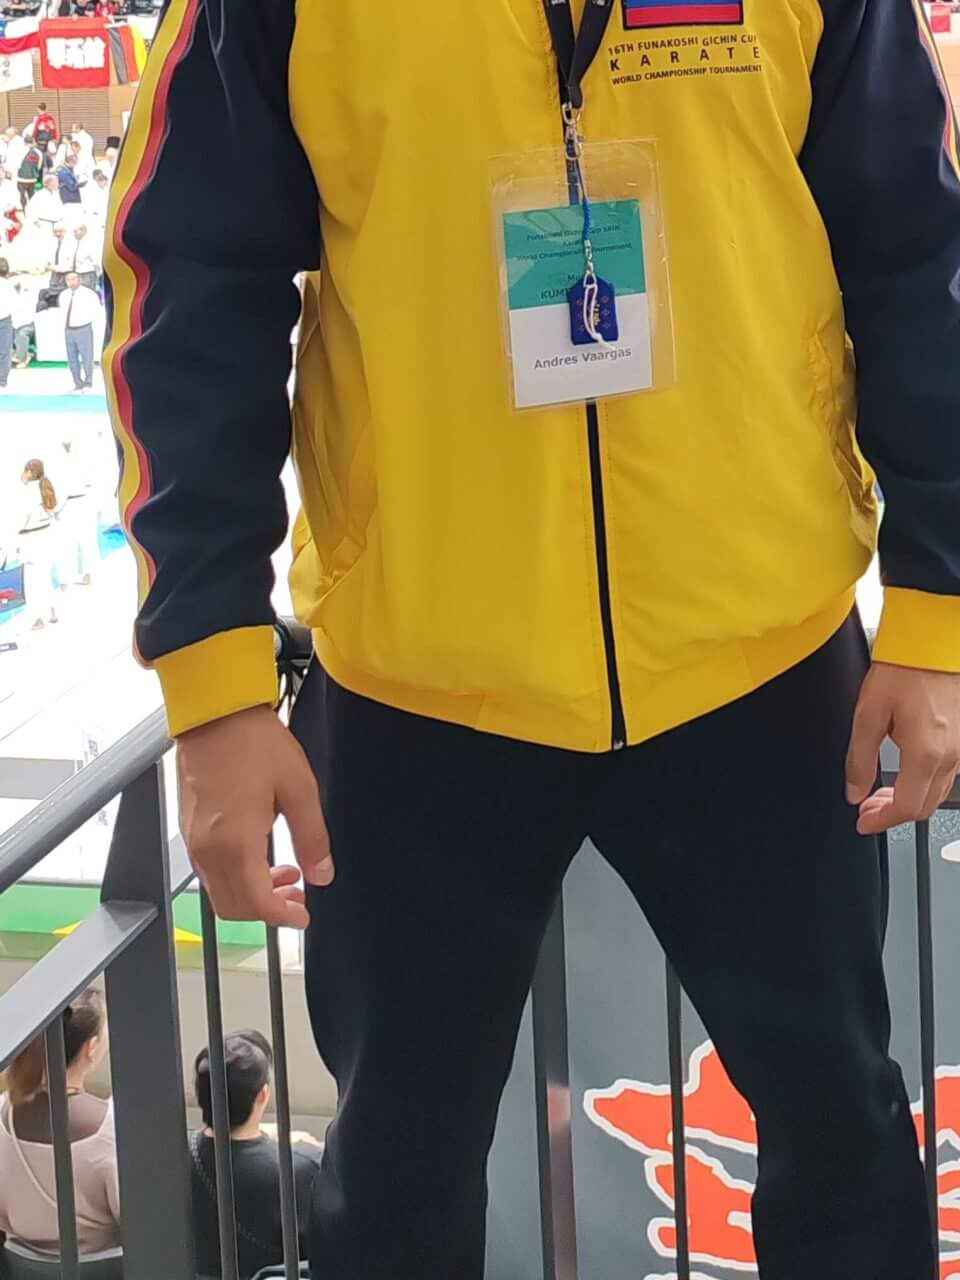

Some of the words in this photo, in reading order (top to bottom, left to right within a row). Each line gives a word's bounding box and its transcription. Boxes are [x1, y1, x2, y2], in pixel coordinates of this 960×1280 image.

[608, 43, 635, 56] 16TH
[637, 36, 699, 52] FUNAKOSHI
[702, 34, 738, 47] GICHIN
[609, 46, 761, 73] KARATE
[611, 73, 642, 86] WORLD
[644, 68, 707, 81] CHAMPIONSHIP
[709, 64, 763, 74] TOURNAMENT
[534, 355, 578, 370] Andres
[581, 347, 632, 363] Vaargas
